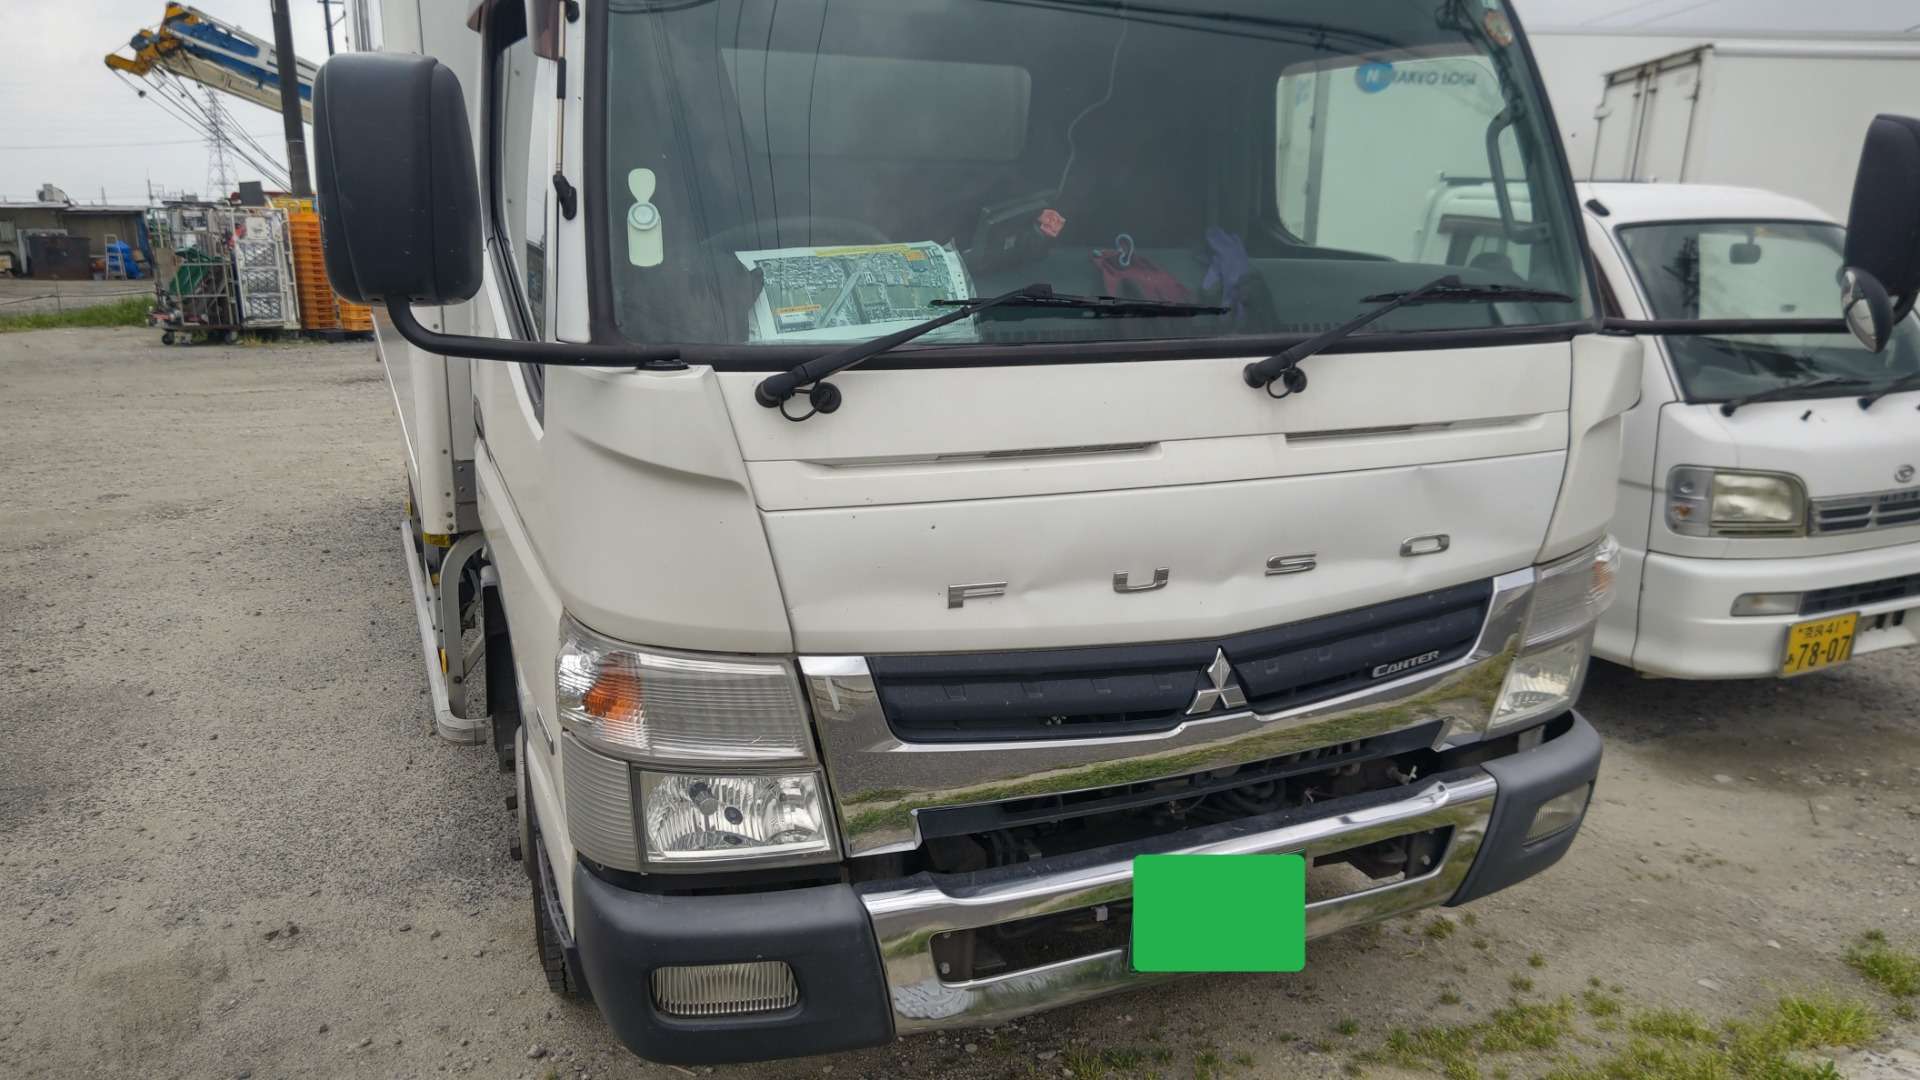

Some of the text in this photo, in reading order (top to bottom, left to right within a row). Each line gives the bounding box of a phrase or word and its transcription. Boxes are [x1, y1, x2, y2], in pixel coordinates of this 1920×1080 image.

[948, 533, 1450, 609] FUSO
[1371, 649, 1440, 678] CANTER
[1796, 635, 1851, 670] 78-07
